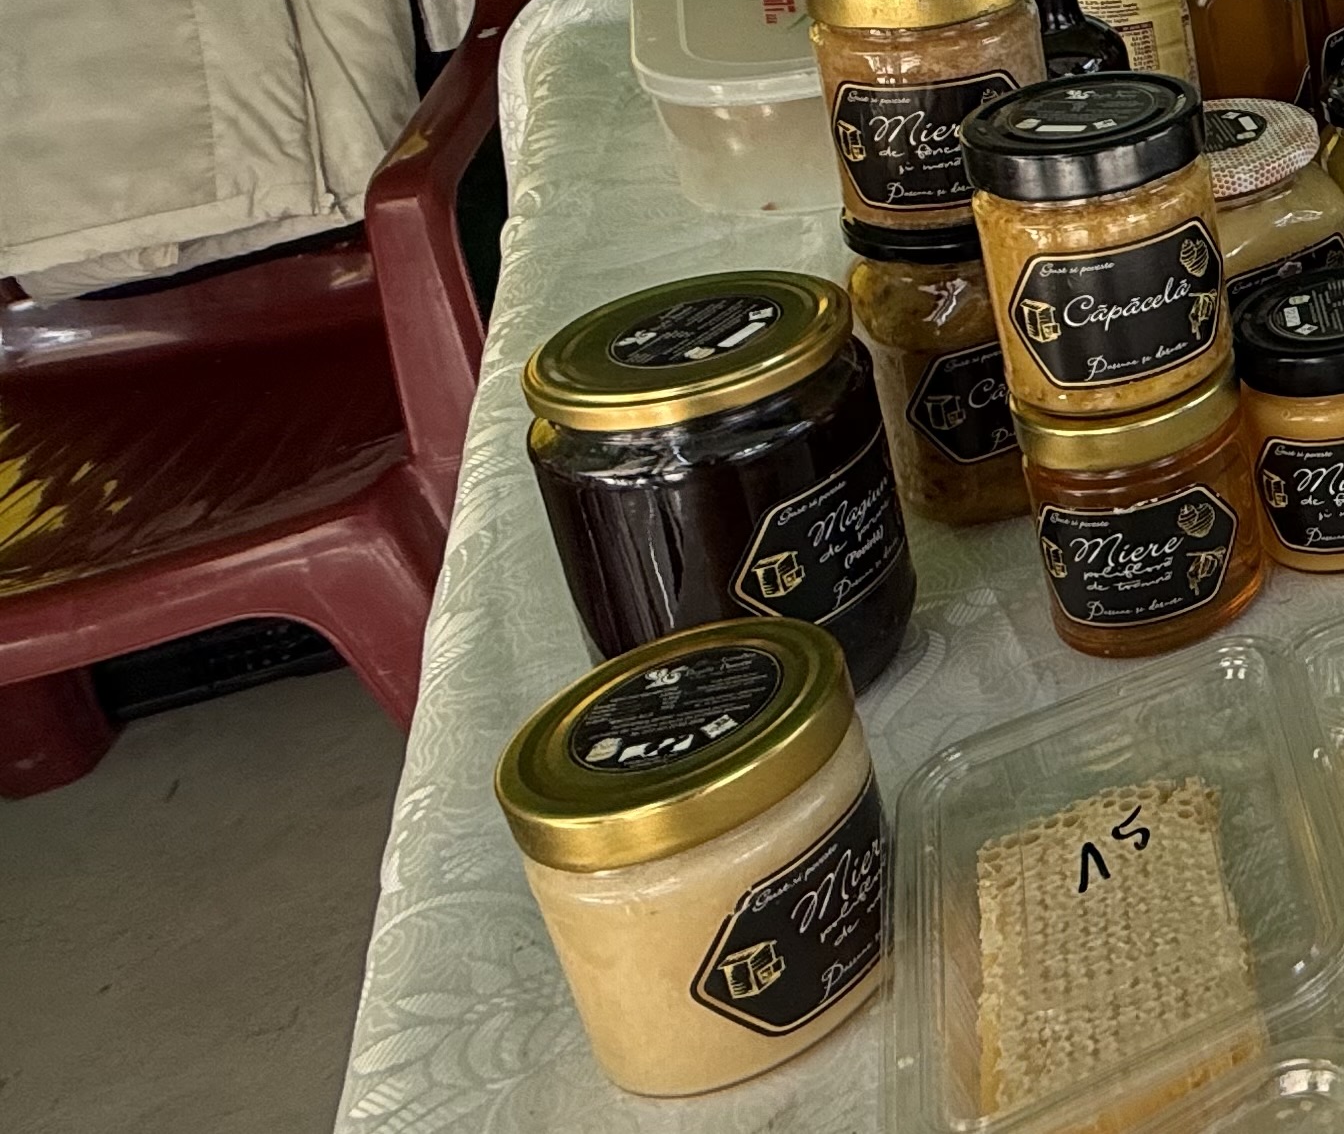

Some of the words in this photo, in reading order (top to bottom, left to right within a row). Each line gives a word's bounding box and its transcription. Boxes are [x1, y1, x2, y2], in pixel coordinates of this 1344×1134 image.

[869, 111, 961, 146] Mier
[1069, 532, 1184, 566] Miere
[1078, 805, 1150, 894] 15
[791, 839, 880, 933] Mier
